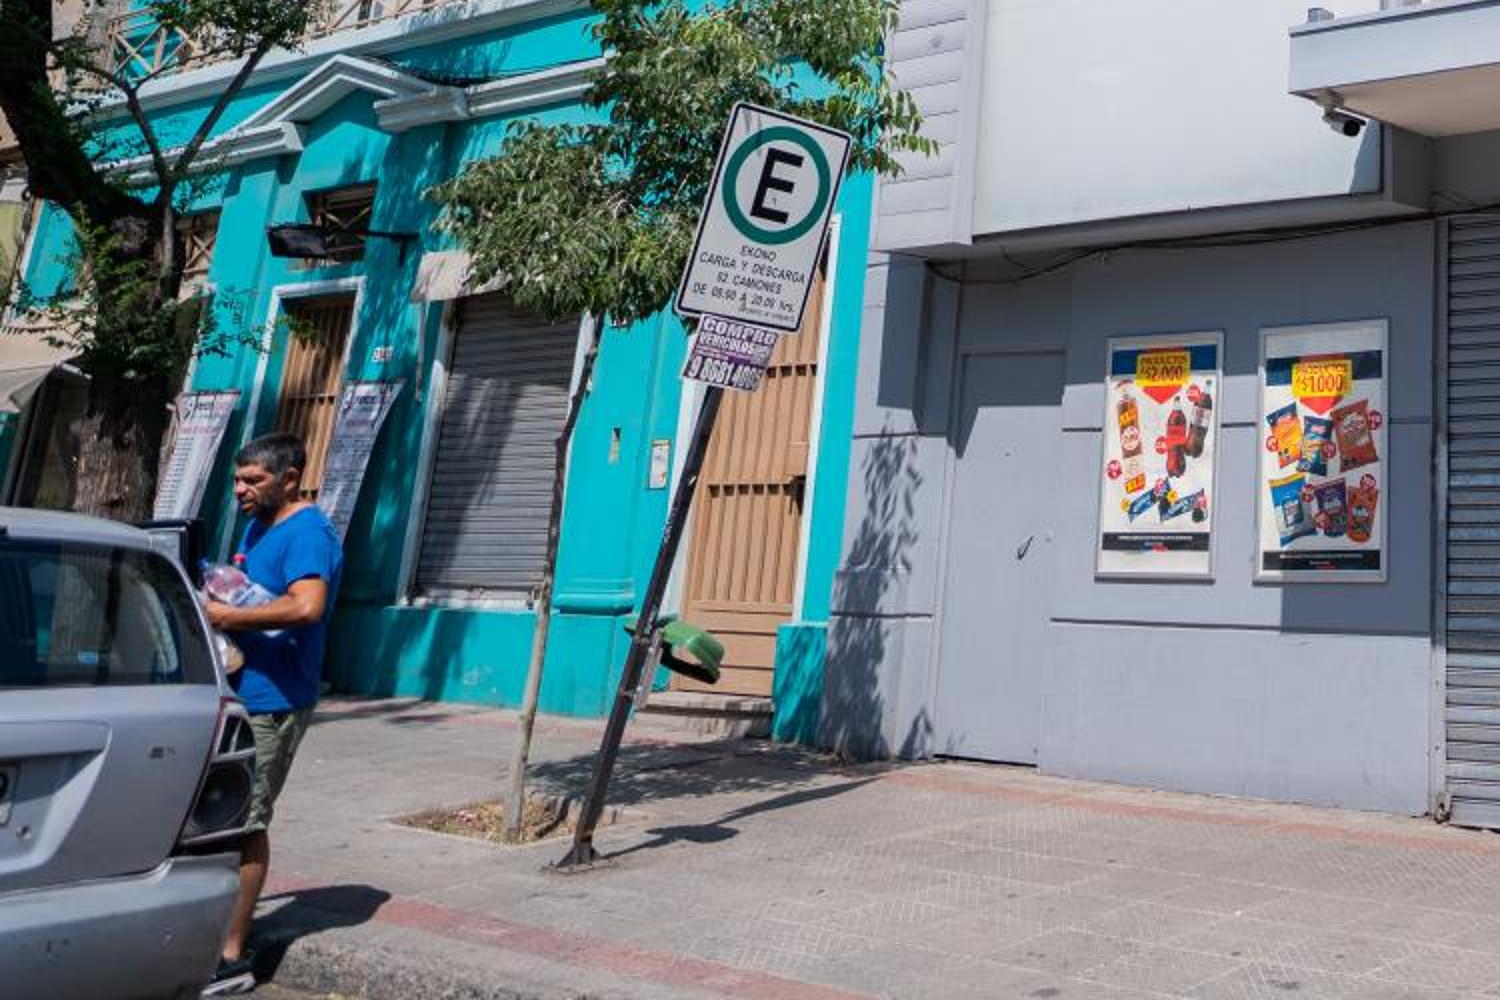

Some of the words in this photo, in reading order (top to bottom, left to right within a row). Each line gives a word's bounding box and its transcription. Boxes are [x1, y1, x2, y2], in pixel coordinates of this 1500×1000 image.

[750, 147, 804, 225] E
[700, 251, 736, 269] CARGA
[742, 260, 750, 271] Y
[751, 263, 805, 284] DESCARGA
[693, 281, 708, 295] DE
[732, 274, 782, 295] CAMIONES
[703, 317, 777, 345] COMPRO
